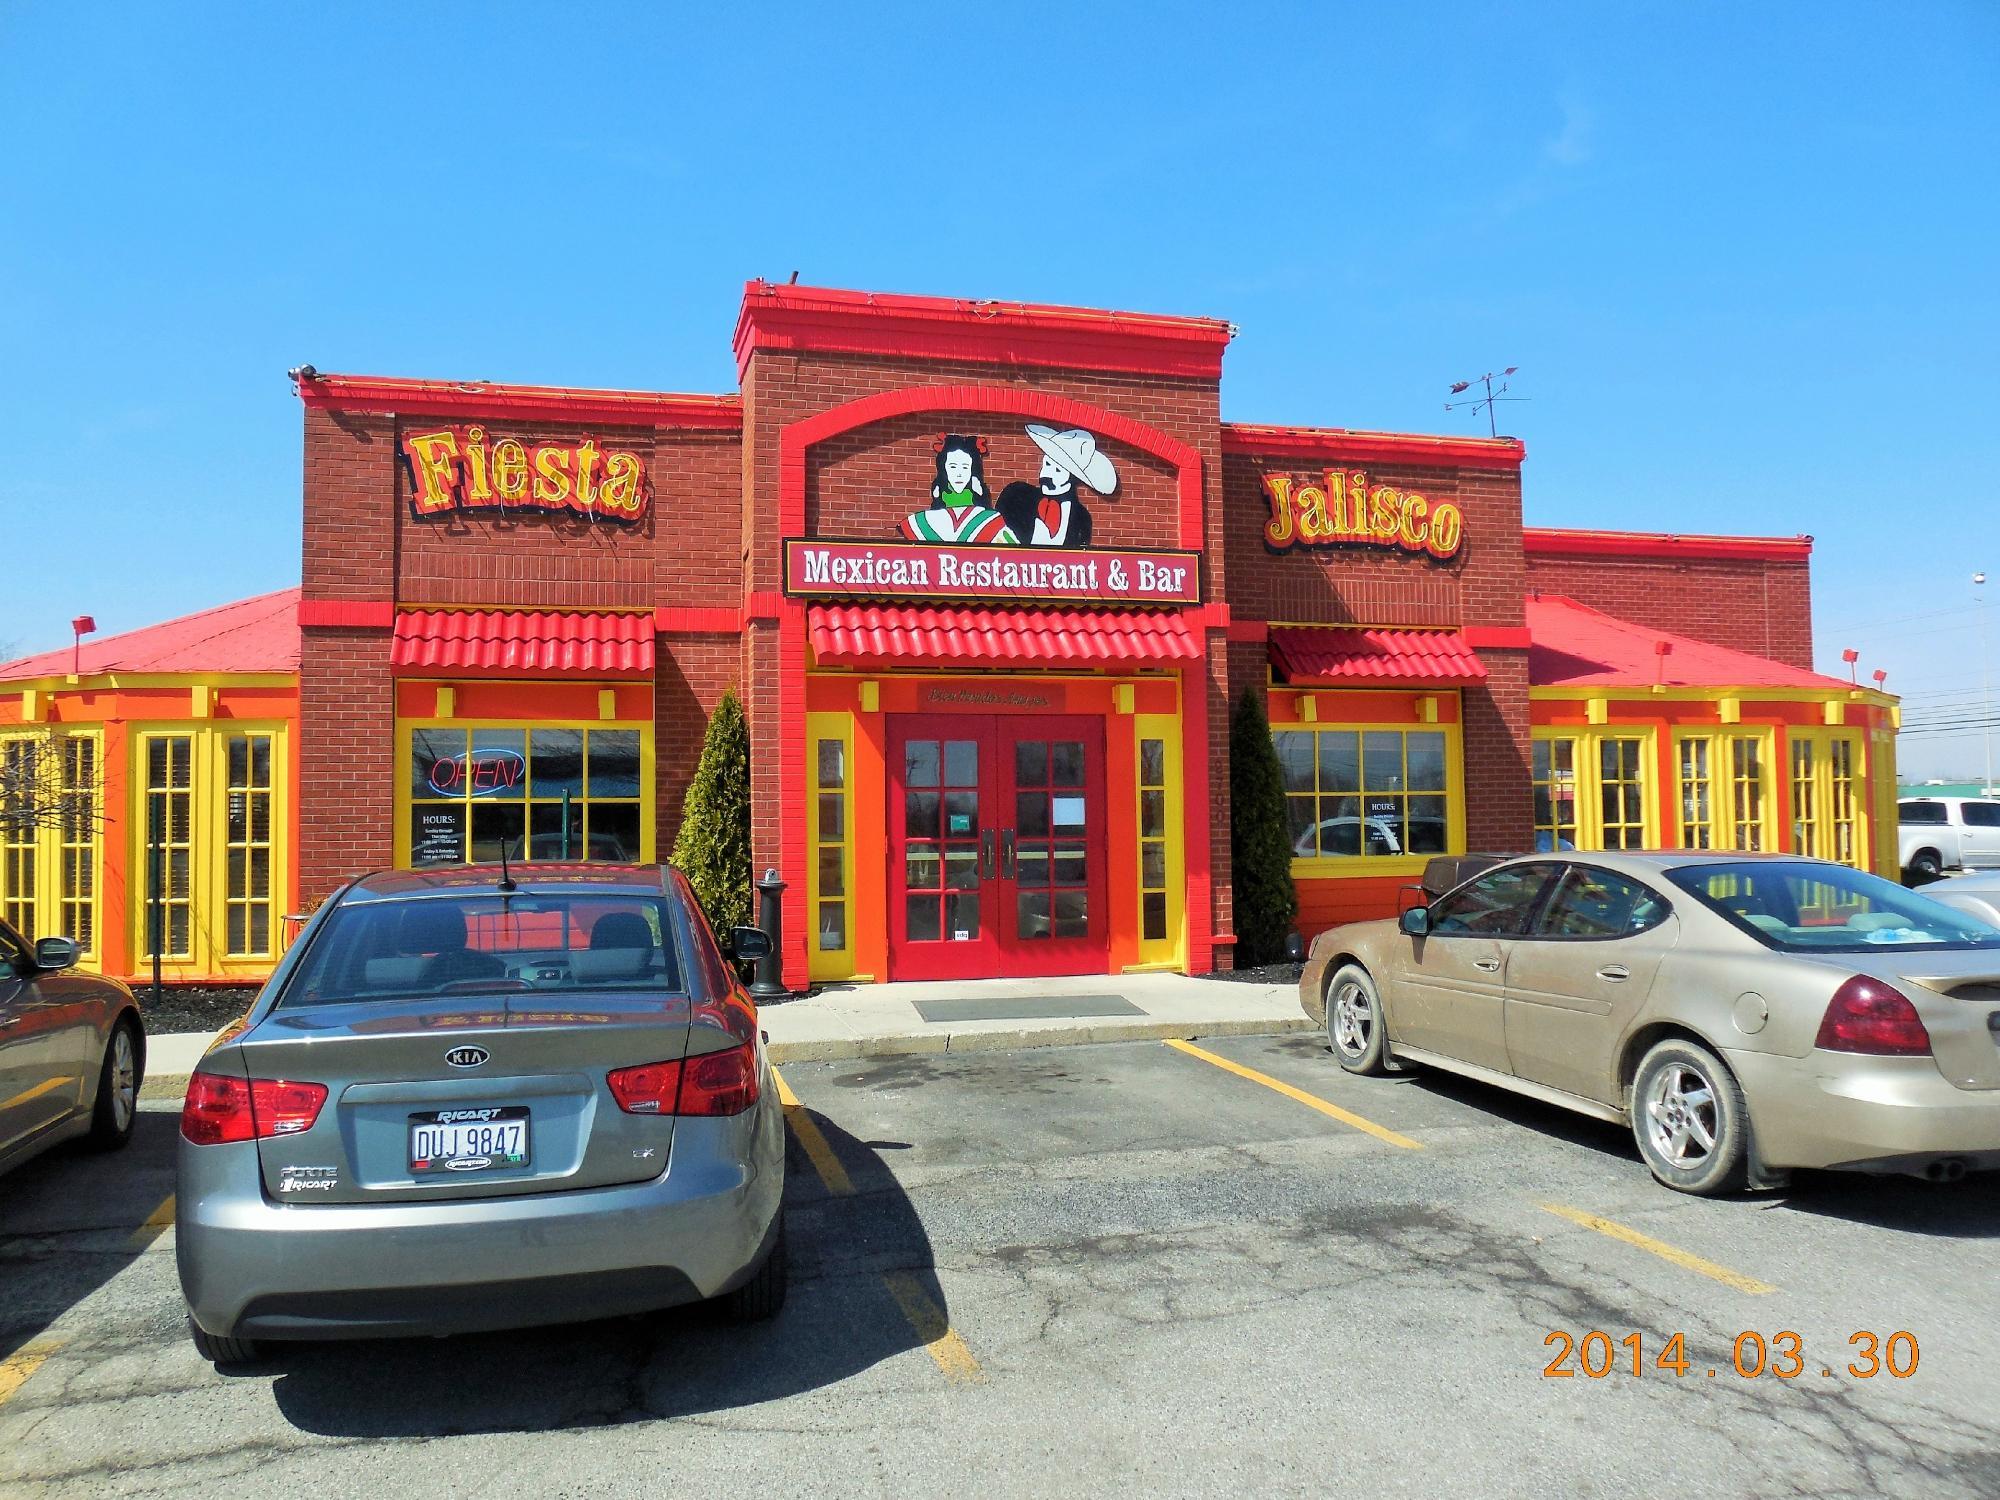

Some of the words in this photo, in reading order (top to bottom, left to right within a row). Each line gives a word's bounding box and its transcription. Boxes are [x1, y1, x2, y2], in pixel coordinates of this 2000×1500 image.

[409, 428, 640, 512] Fiesta
[1267, 472, 1461, 551] Jalisco
[803, 550, 929, 586] Mexican
[938, 553, 1099, 590] Restaurant
[1107, 559, 1129, 592] &
[1137, 560, 1187, 593] Bar
[431, 757, 518, 788] OPEN
[422, 815, 456, 825] HOURS:
[452, 1050, 483, 1064] KIA
[437, 1108, 502, 1124] RICART
[418, 1129, 458, 1160] DUJ
[466, 1126, 520, 1156] 9847
[280, 1165, 338, 1178] FORTE
